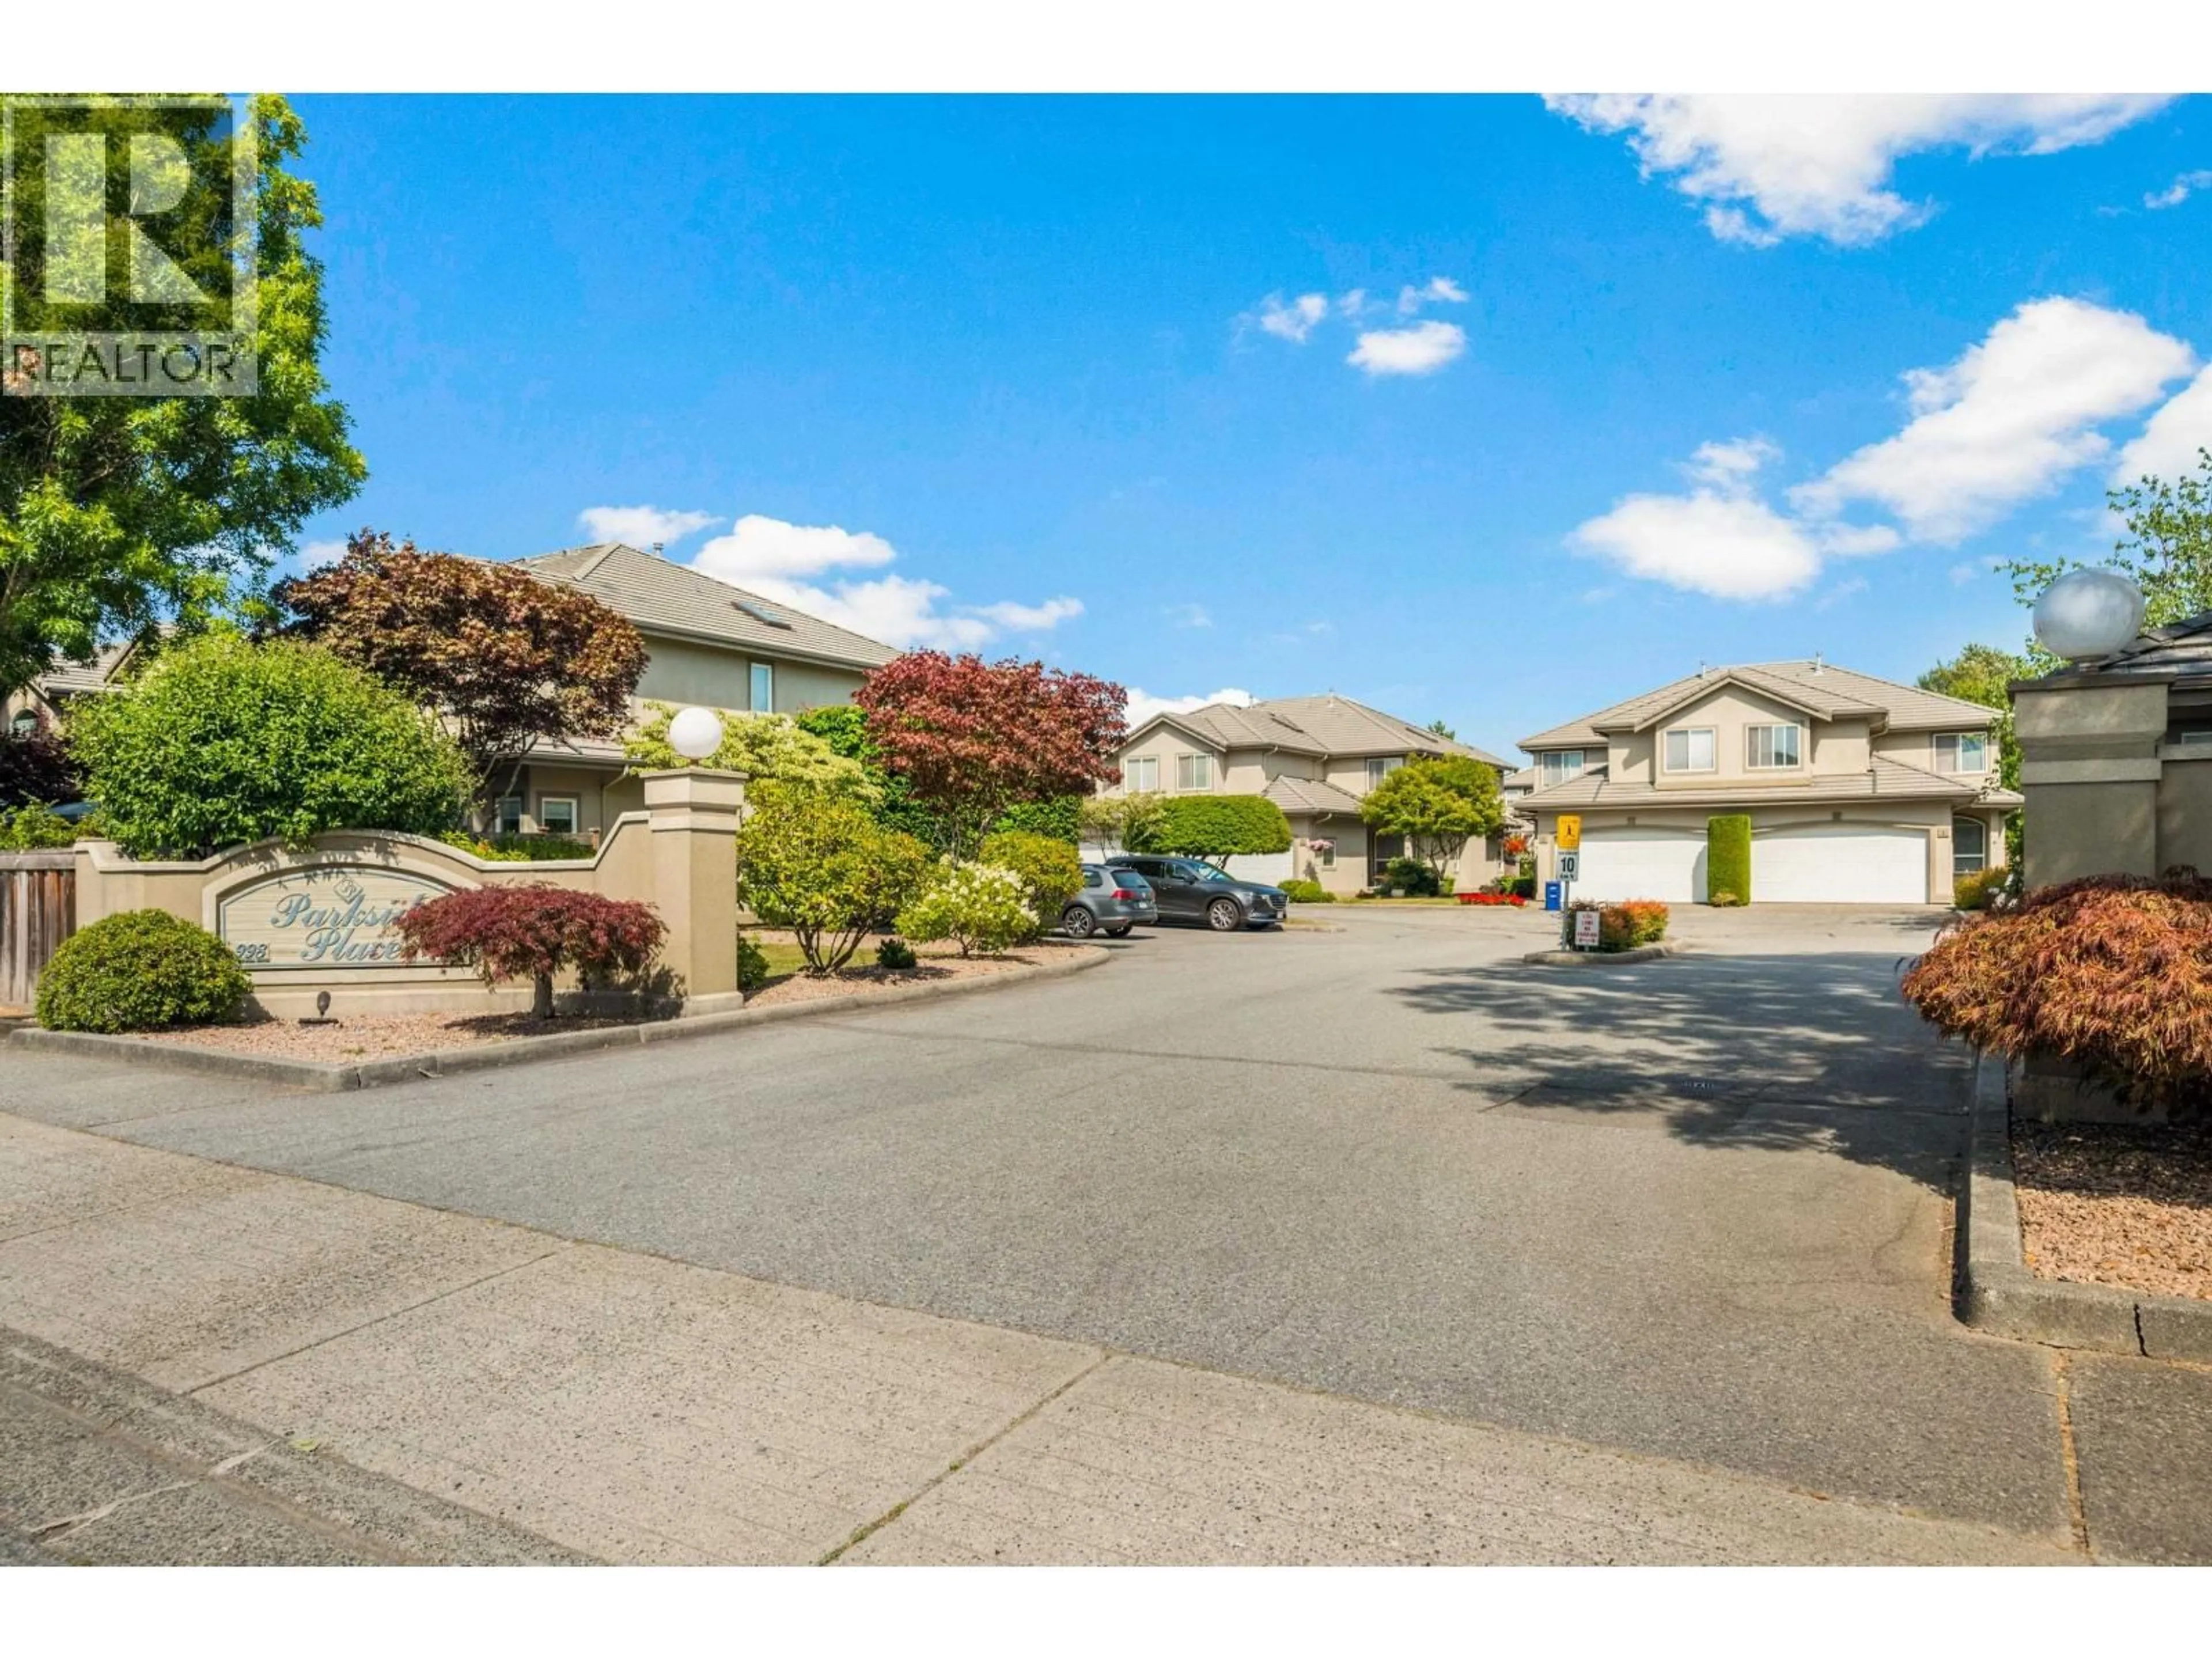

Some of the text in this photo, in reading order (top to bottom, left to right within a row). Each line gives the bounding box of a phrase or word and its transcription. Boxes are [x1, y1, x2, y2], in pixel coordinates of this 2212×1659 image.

[1560, 857, 1574, 873] 10
[270, 892, 427, 928] Parksi
[300, 927, 401, 961] Place
